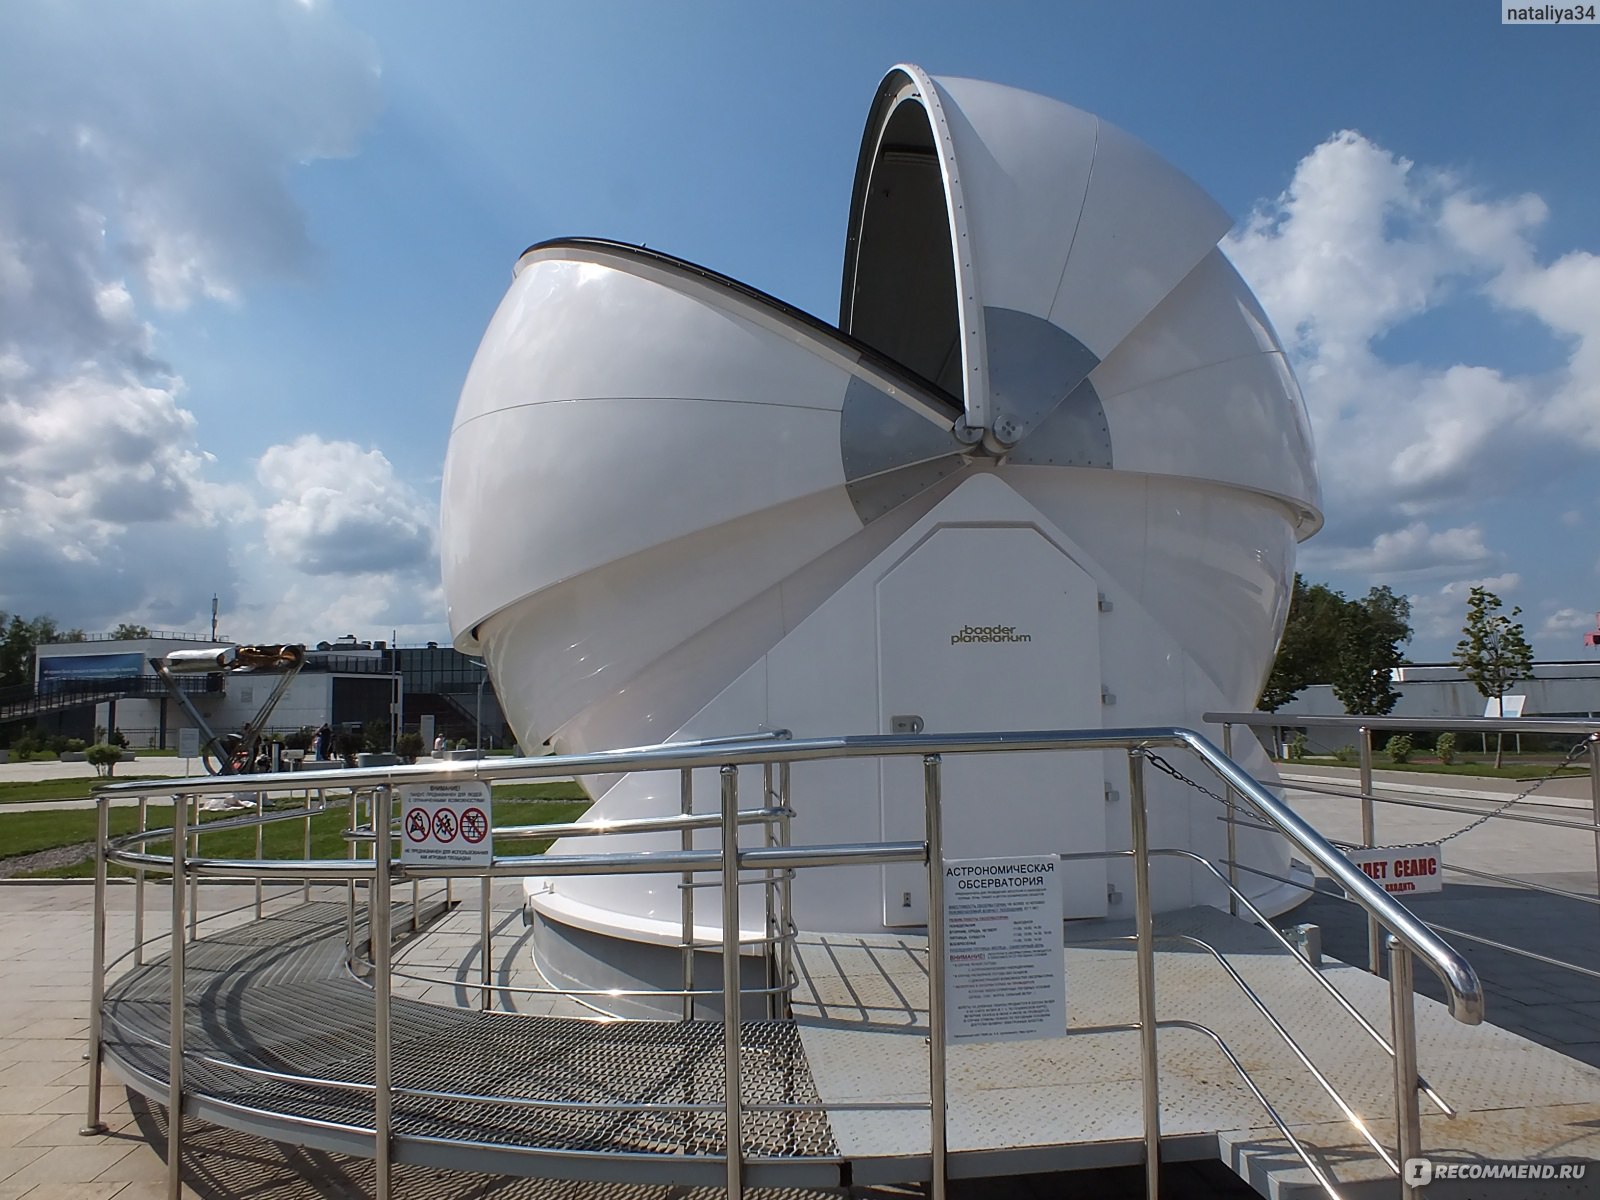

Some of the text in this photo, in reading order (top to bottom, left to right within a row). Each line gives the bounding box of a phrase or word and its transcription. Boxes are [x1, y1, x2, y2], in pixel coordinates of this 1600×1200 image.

[946, 863, 1055, 877] АСТРОНОМИЧЕСКАЯ
[1394, 858, 1437, 878] СЕАНС
[958, 876, 1045, 890] ОБСЕРВАТОРИЯ
